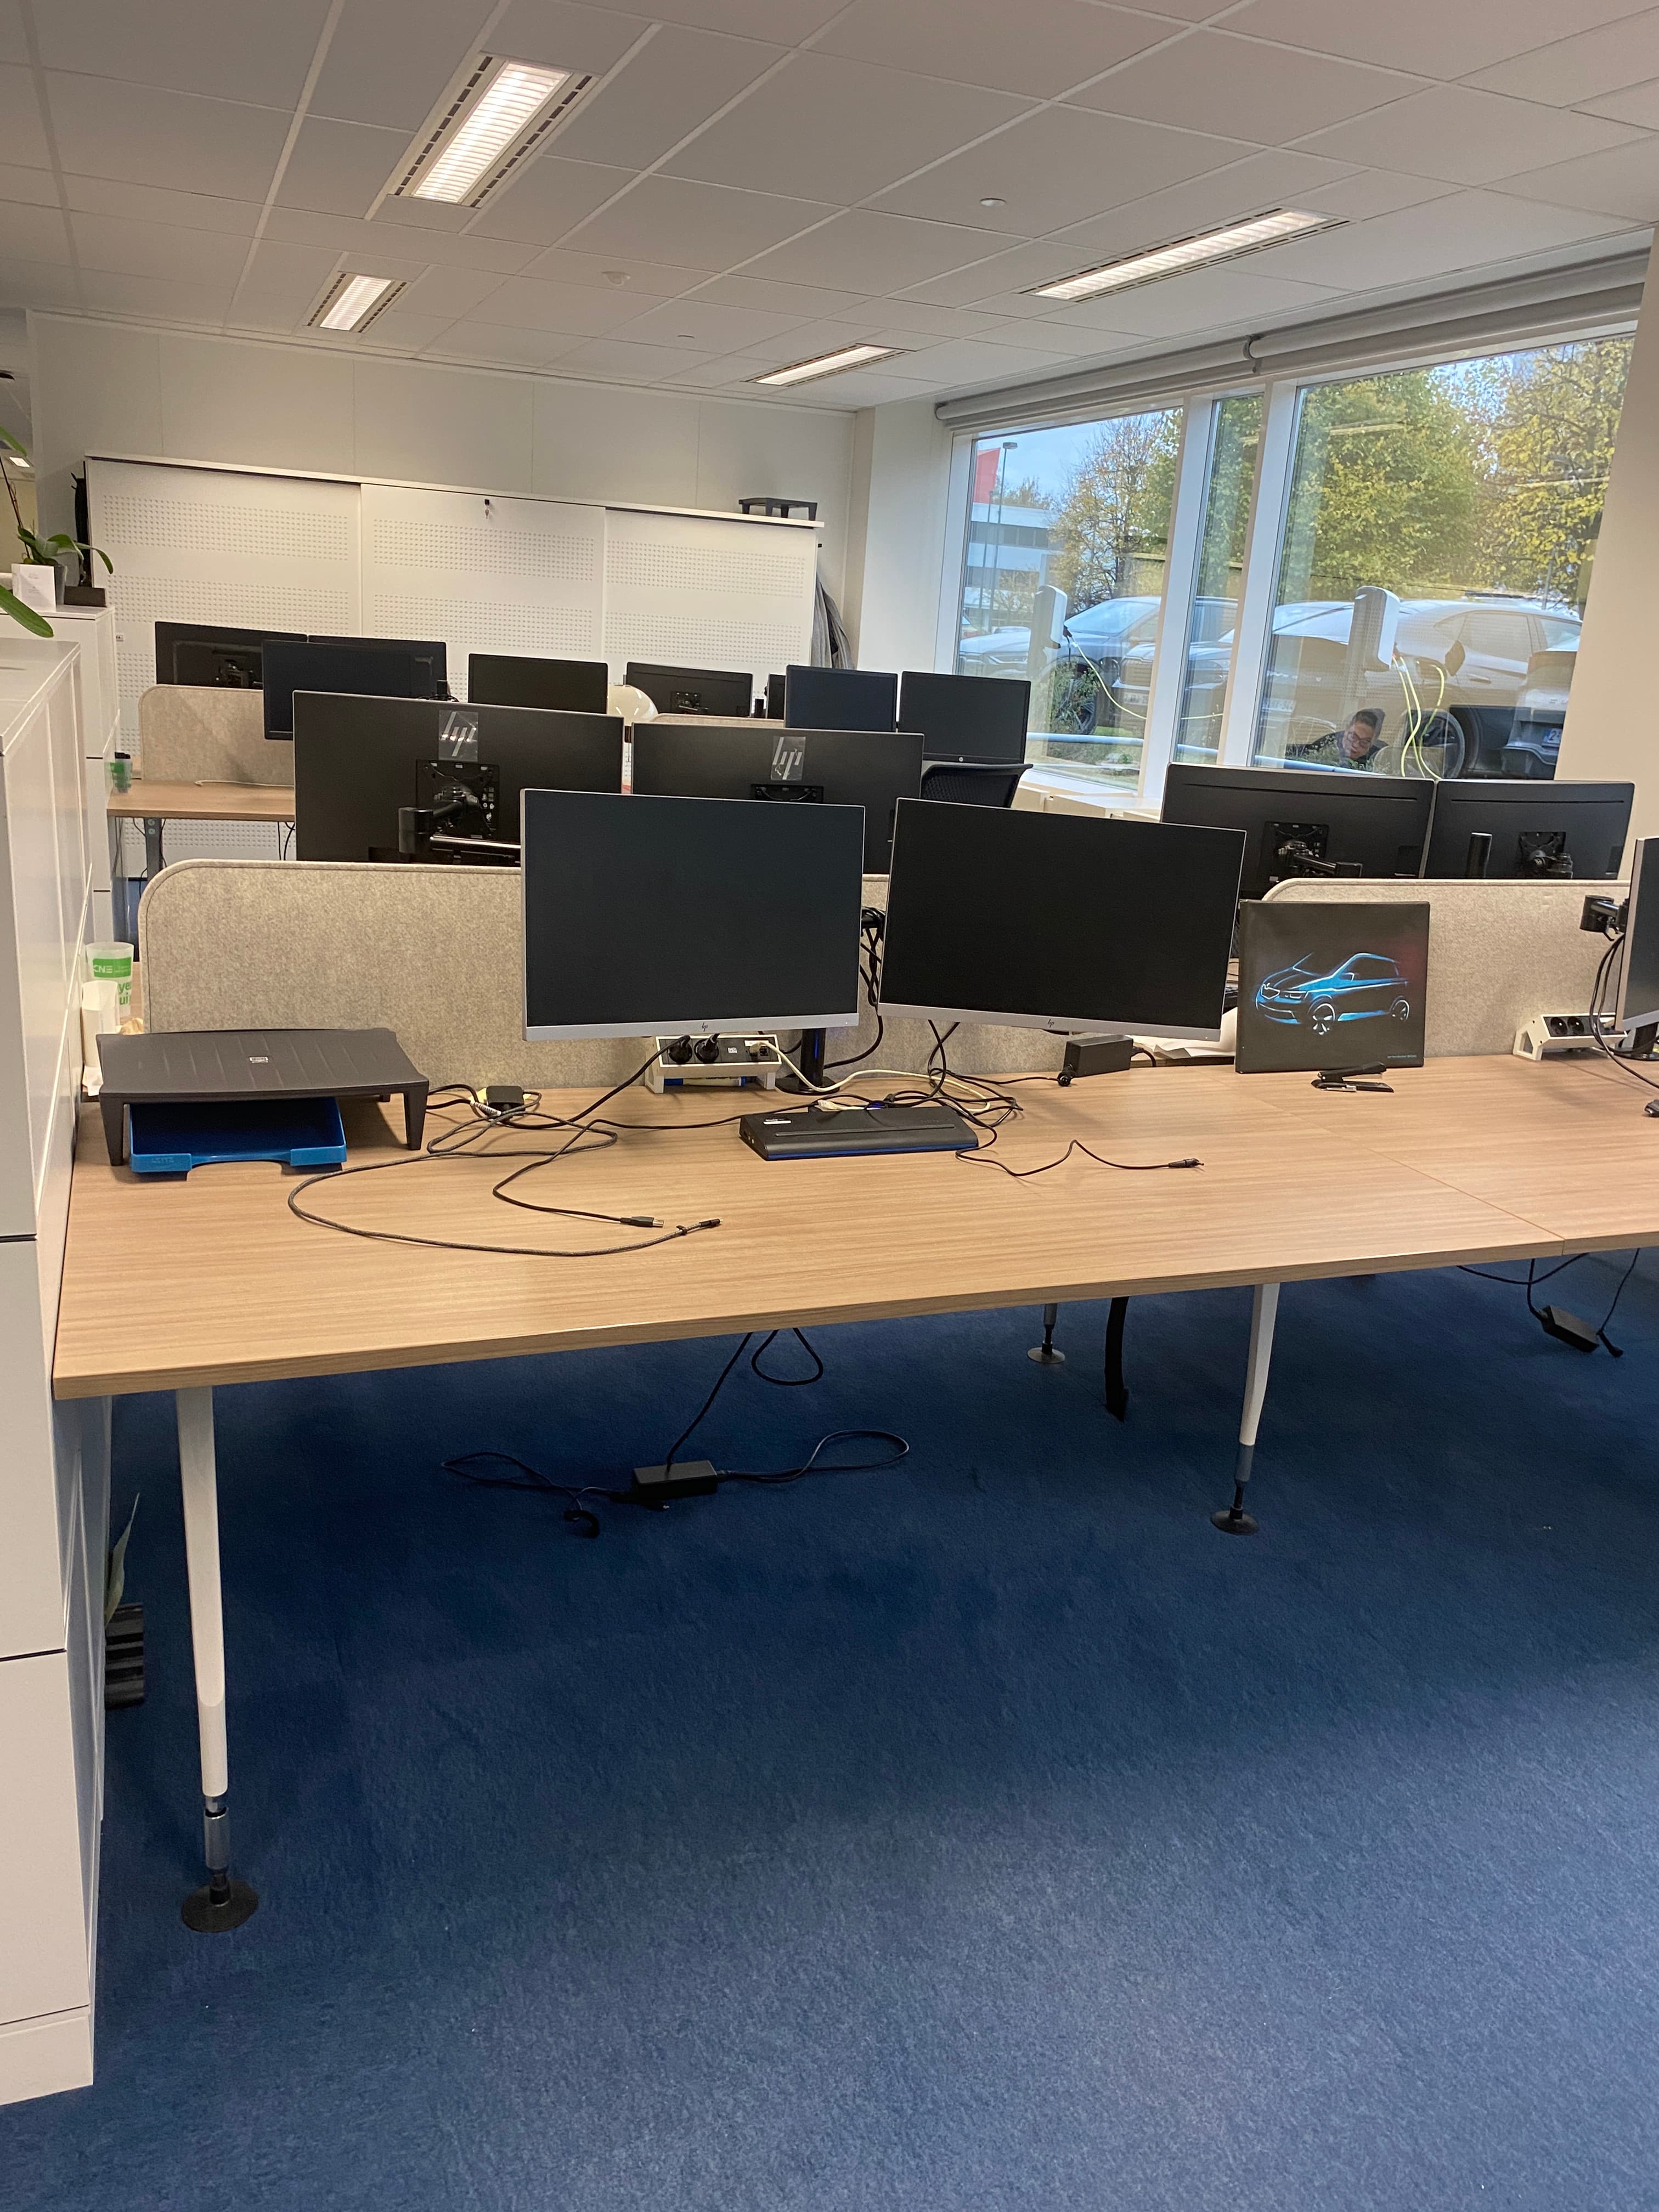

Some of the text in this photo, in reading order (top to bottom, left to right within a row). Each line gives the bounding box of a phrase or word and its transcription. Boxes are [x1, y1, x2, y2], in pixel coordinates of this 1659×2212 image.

[772, 737, 802, 780] hp
[702, 1022, 708, 1032] hp
[1047, 1018, 1054, 1028] hp
